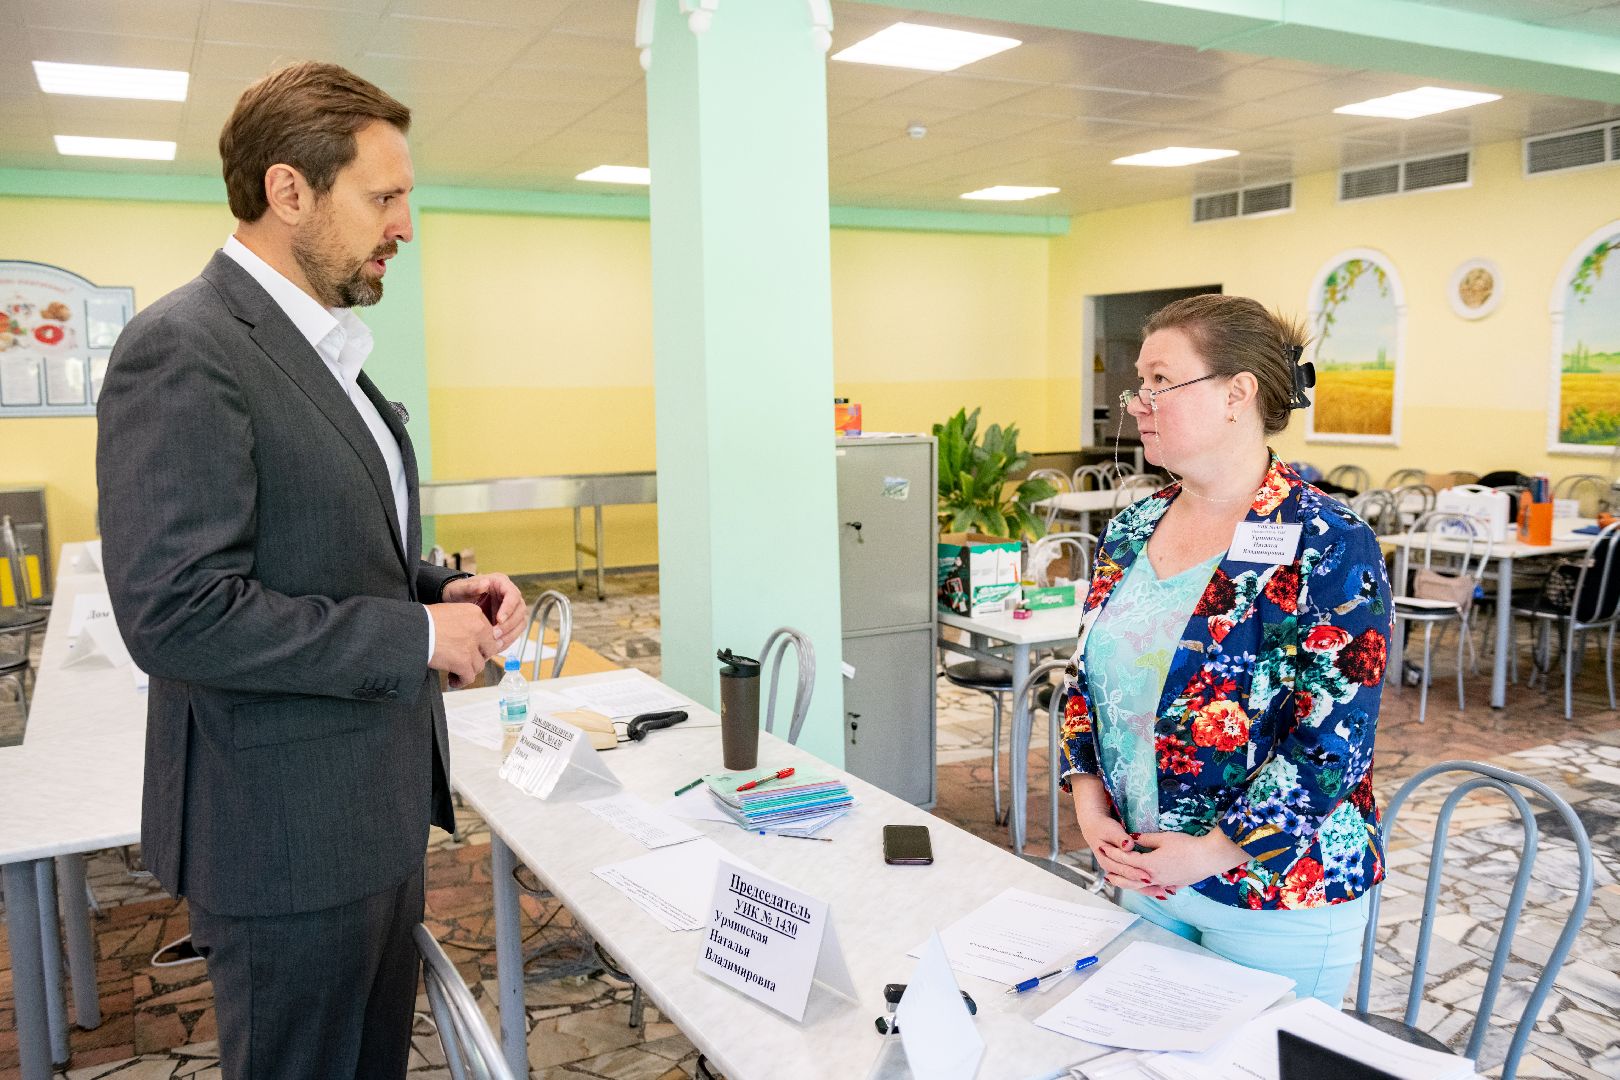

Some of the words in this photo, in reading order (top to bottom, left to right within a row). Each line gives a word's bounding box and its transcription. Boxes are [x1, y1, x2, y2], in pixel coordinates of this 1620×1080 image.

[729, 872, 812, 922] Председатель
[713, 909, 769, 945] Урминская
[734, 898, 761, 920] УИК
[760, 908, 774, 927] №
[774, 914, 799, 938] 1430
[708, 928, 751, 958] Наталья
[704, 946, 777, 993] Владимировна
